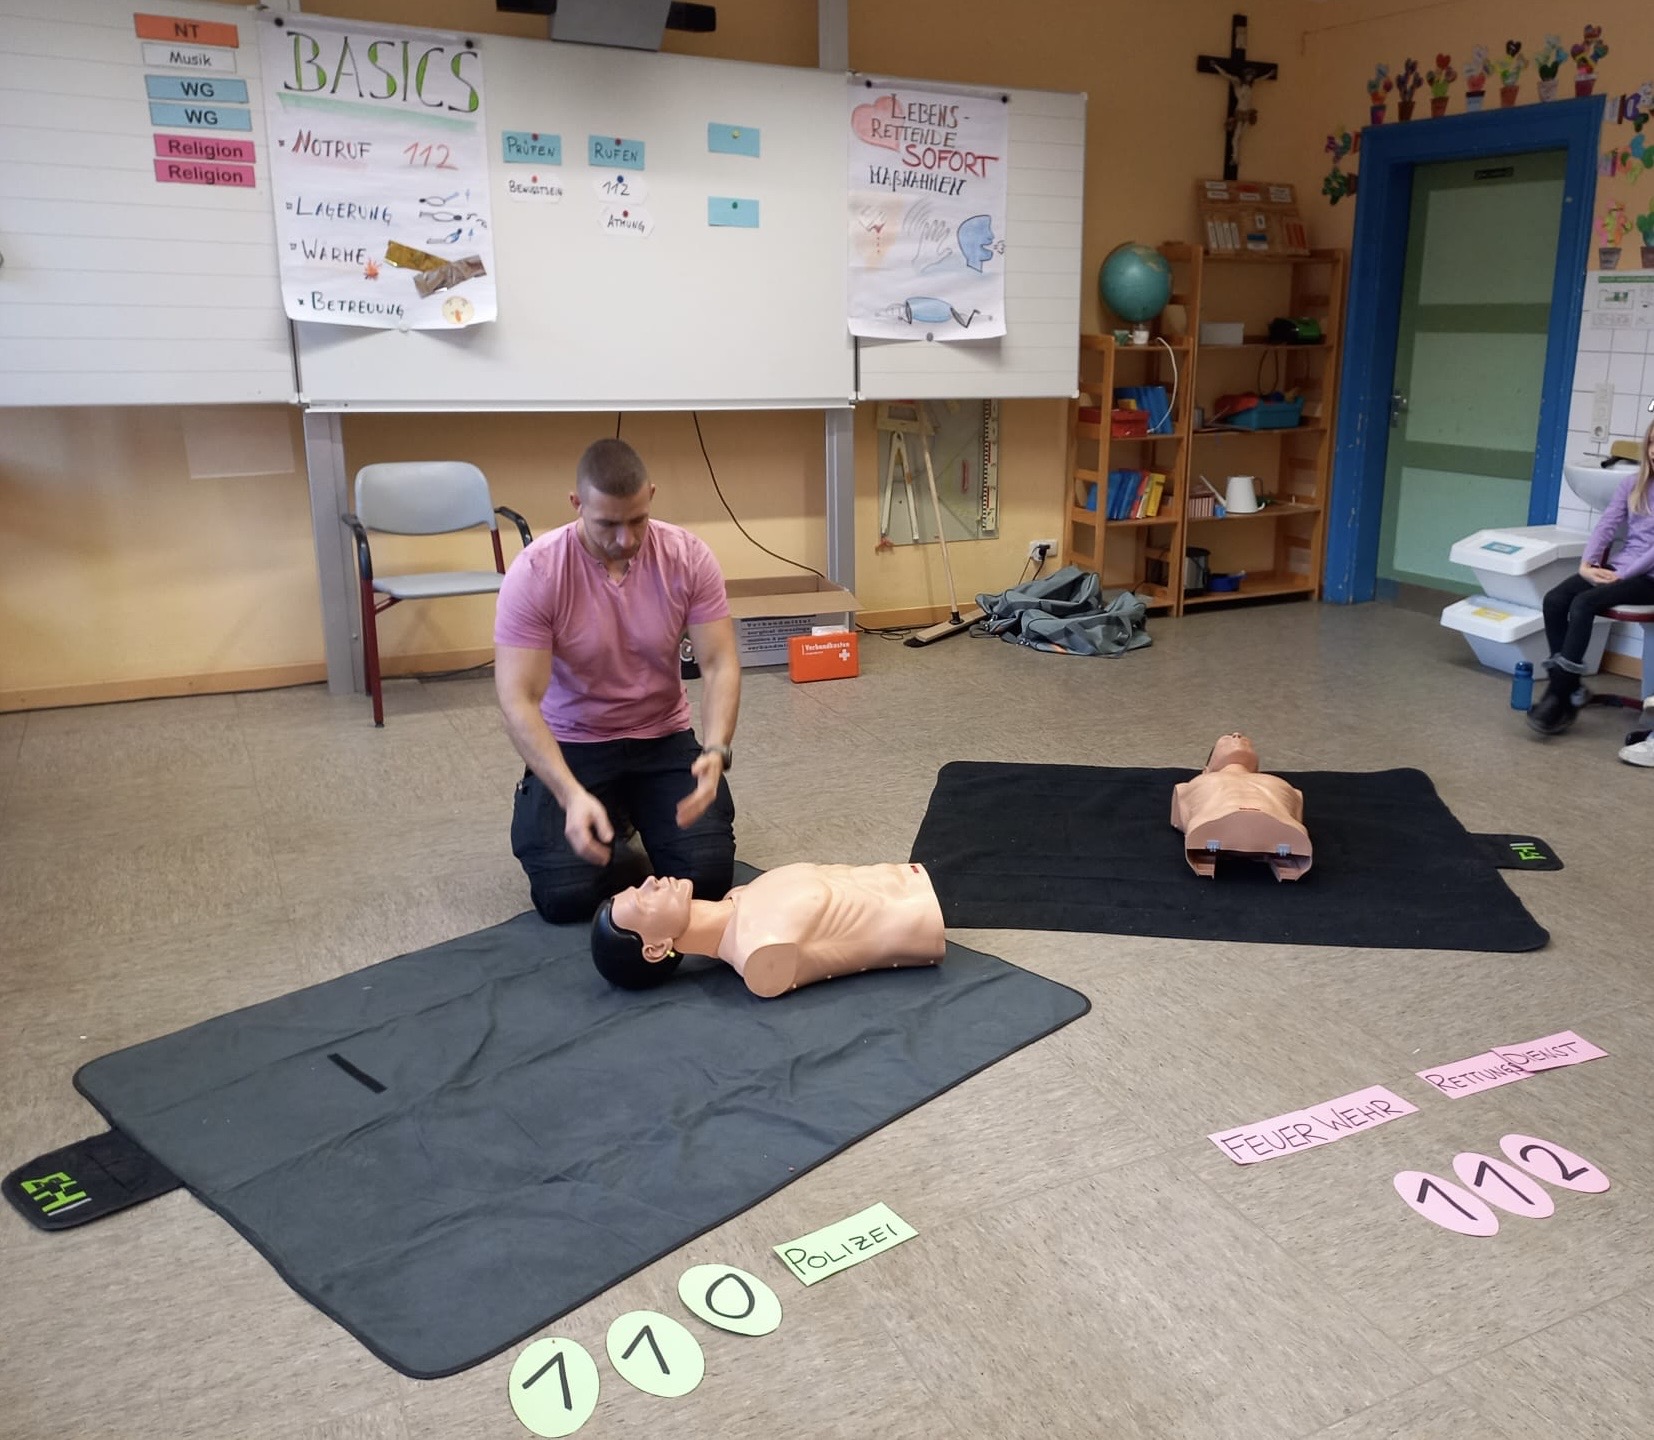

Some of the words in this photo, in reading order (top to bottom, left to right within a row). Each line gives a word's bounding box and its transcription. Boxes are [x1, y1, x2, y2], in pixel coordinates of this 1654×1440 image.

[174, 24, 199, 38] NT
[169, 51, 212, 67] Musik
[283, 31, 479, 113] BASICS
[180, 82, 215, 98] WG
[185, 110, 219, 126] WG
[871, 118, 957, 148] RETTENDE
[168, 138, 244, 160] Religion
[291, 129, 371, 159] NOTRUF
[403, 142, 459, 171] 112
[506, 136, 555, 157] PRÜFEN
[594, 142, 638, 162] RUFEN
[902, 143, 999, 178] SOFORT
[168, 163, 244, 184] Religion
[602, 181, 630, 196] 112
[296, 196, 392, 225] LAGERUNG
[784, 1223, 898, 1275] POLIZEI
